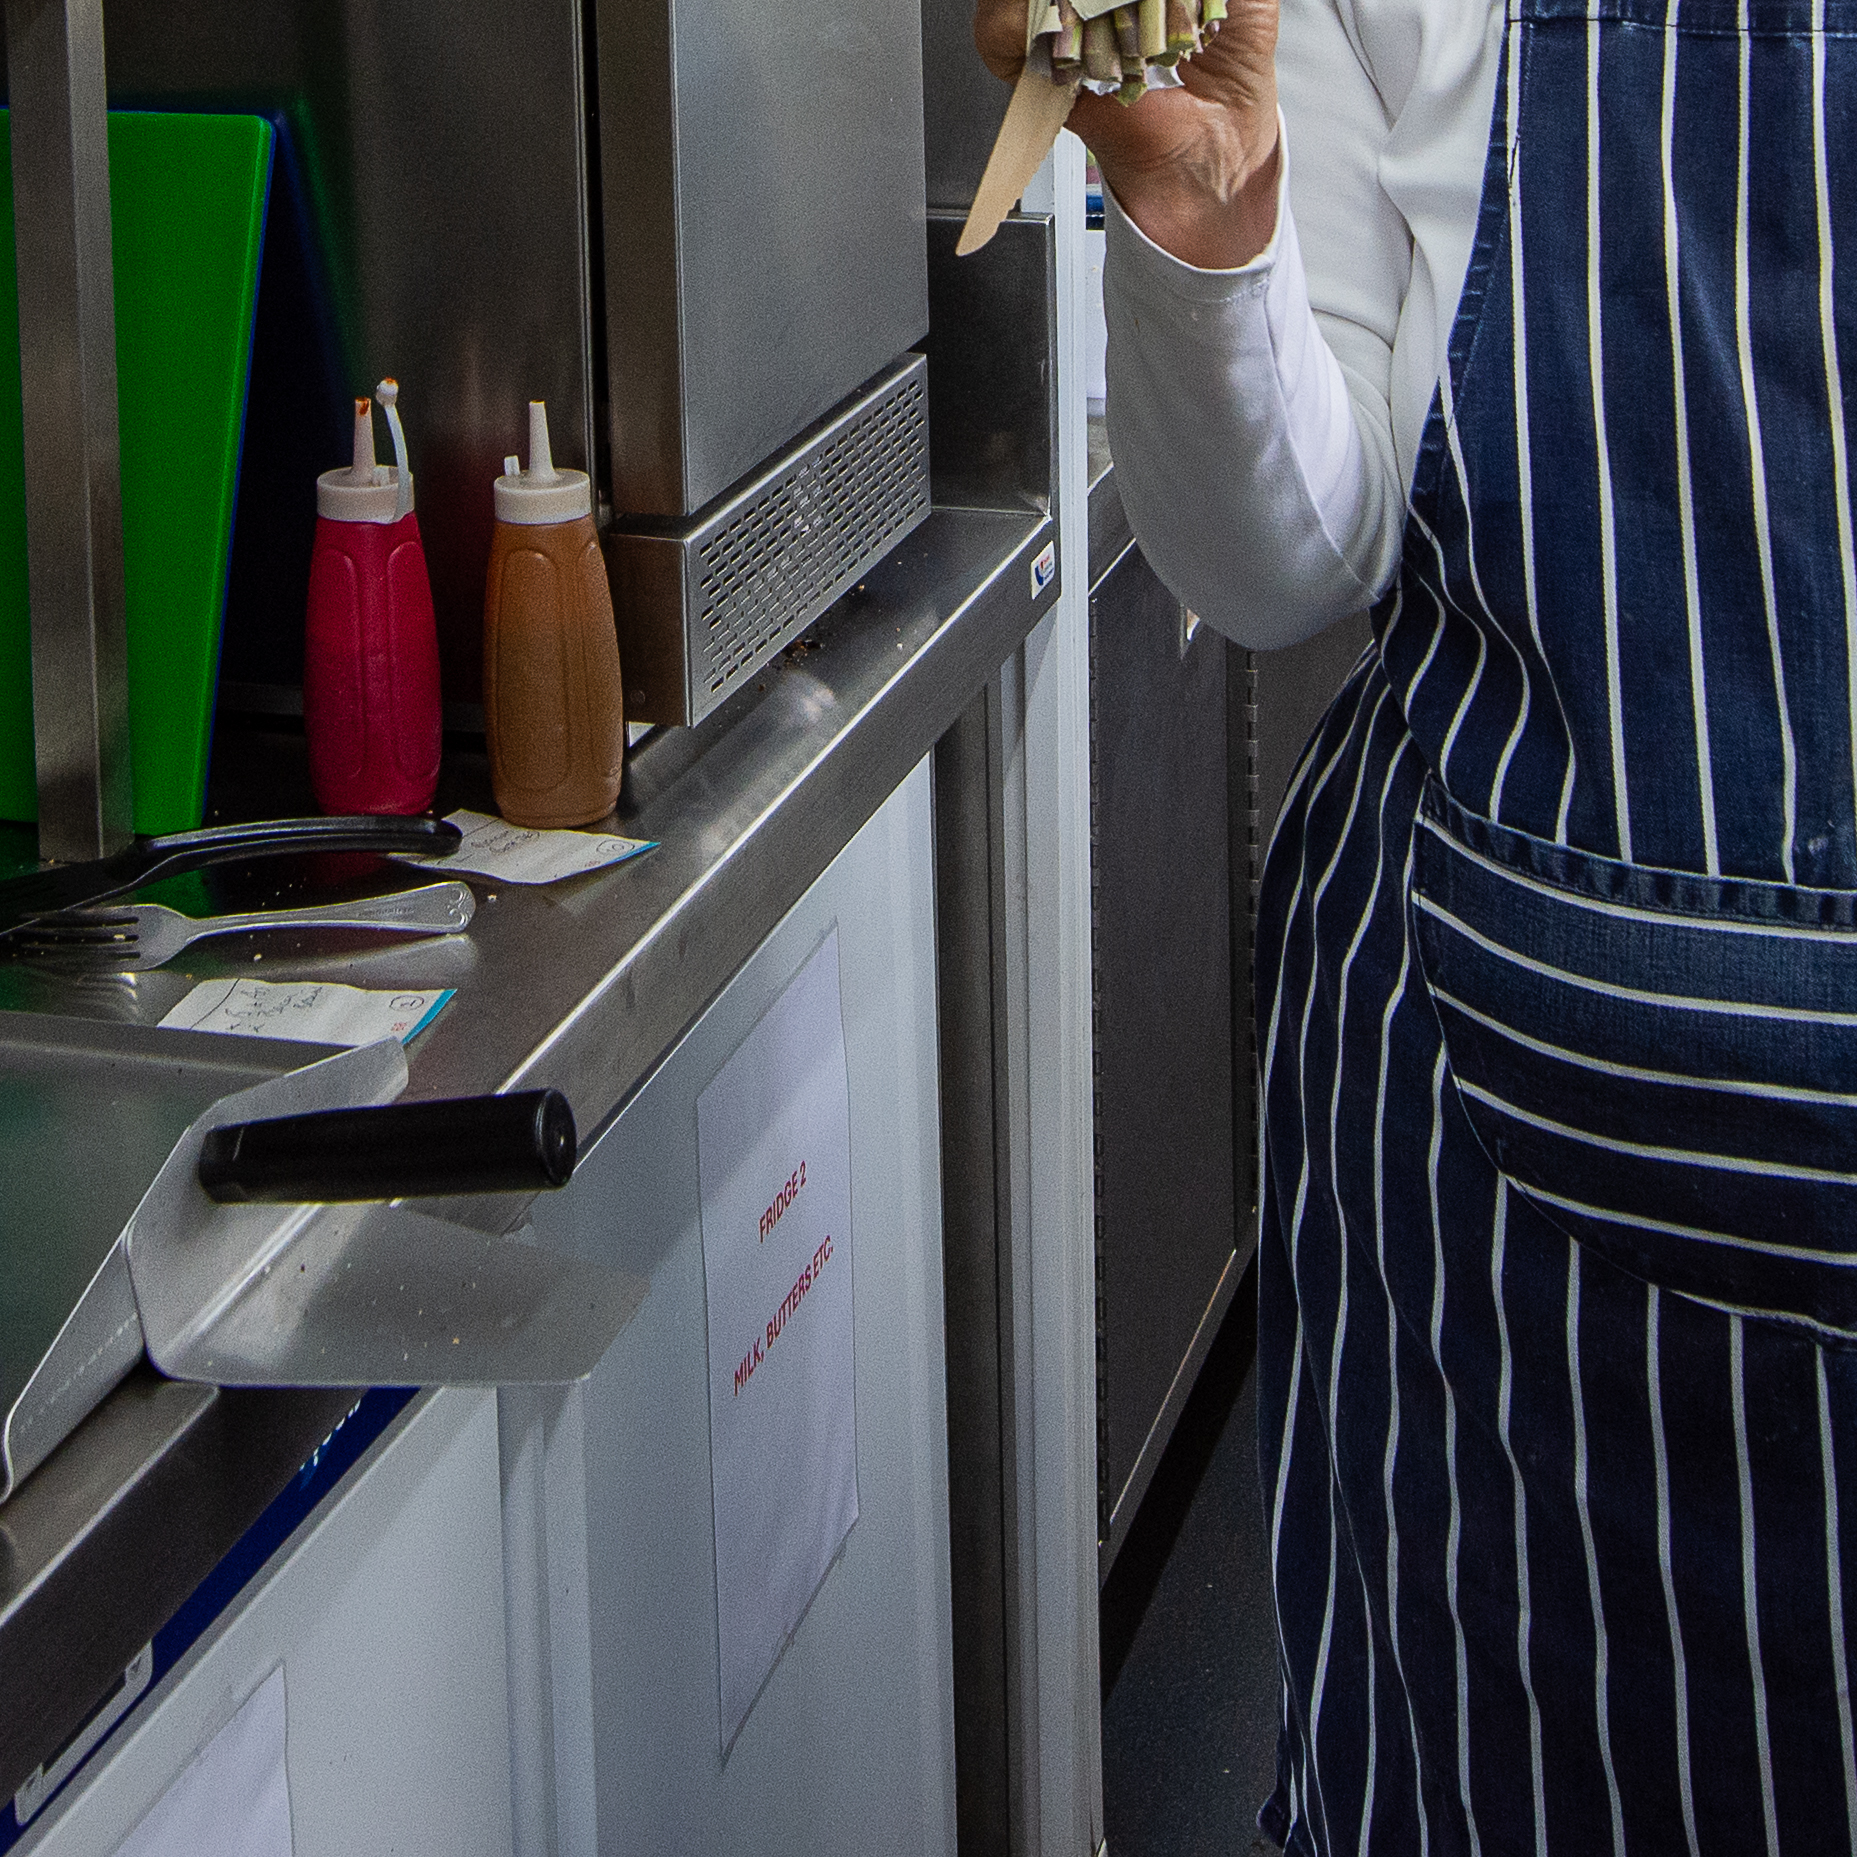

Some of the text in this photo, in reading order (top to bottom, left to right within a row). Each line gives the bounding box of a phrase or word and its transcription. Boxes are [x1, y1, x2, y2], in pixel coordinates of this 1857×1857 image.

[759, 1160, 807, 1243] FRIDGE 2
[734, 1235, 834, 1396] MILK, BUTTERS ETC.
